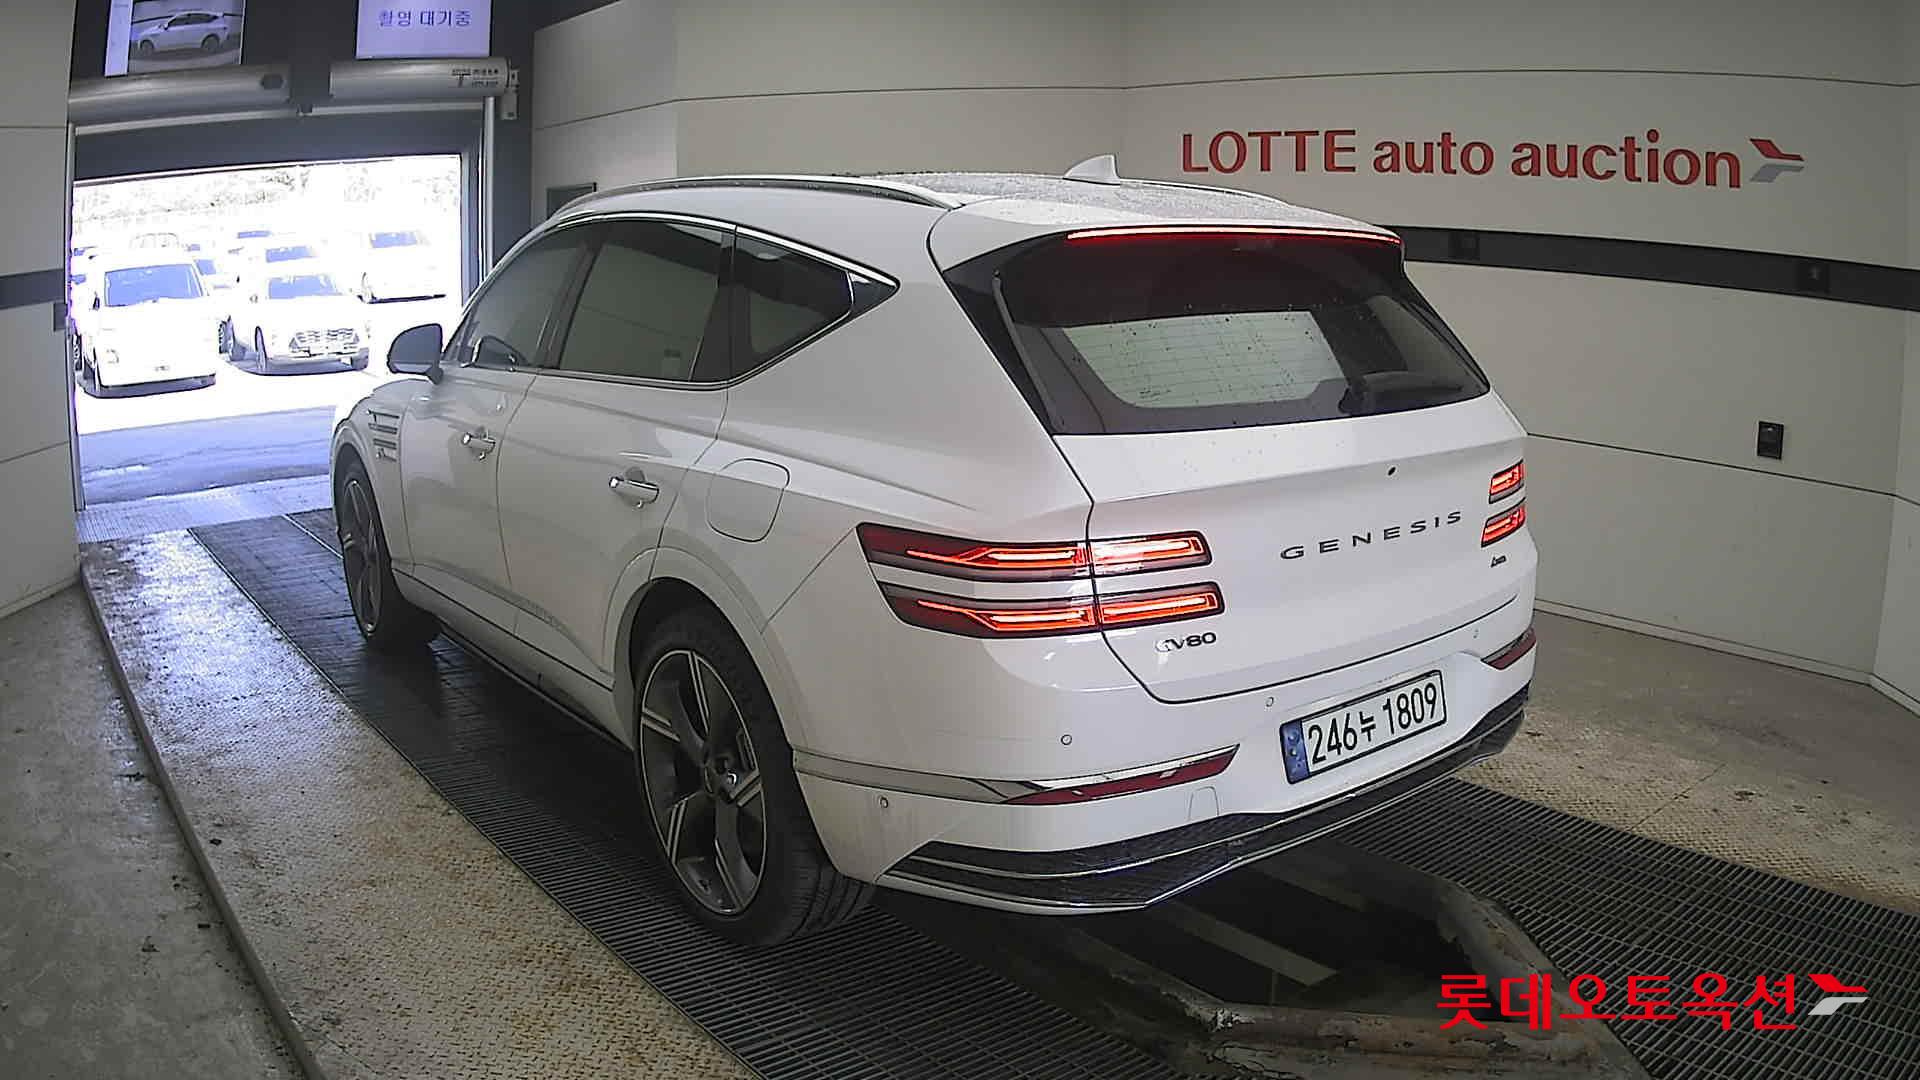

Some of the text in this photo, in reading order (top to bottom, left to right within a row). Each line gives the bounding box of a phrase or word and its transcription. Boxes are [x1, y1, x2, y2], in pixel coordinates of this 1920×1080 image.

[420, 9, 470, 27] 대기중
[1182, 129, 1741, 188] LOTTE auto auction
[1280, 511, 1462, 560] GENESIS
[1156, 632, 1217, 652] GV80
[1308, 682, 1437, 765] 246누 1809
